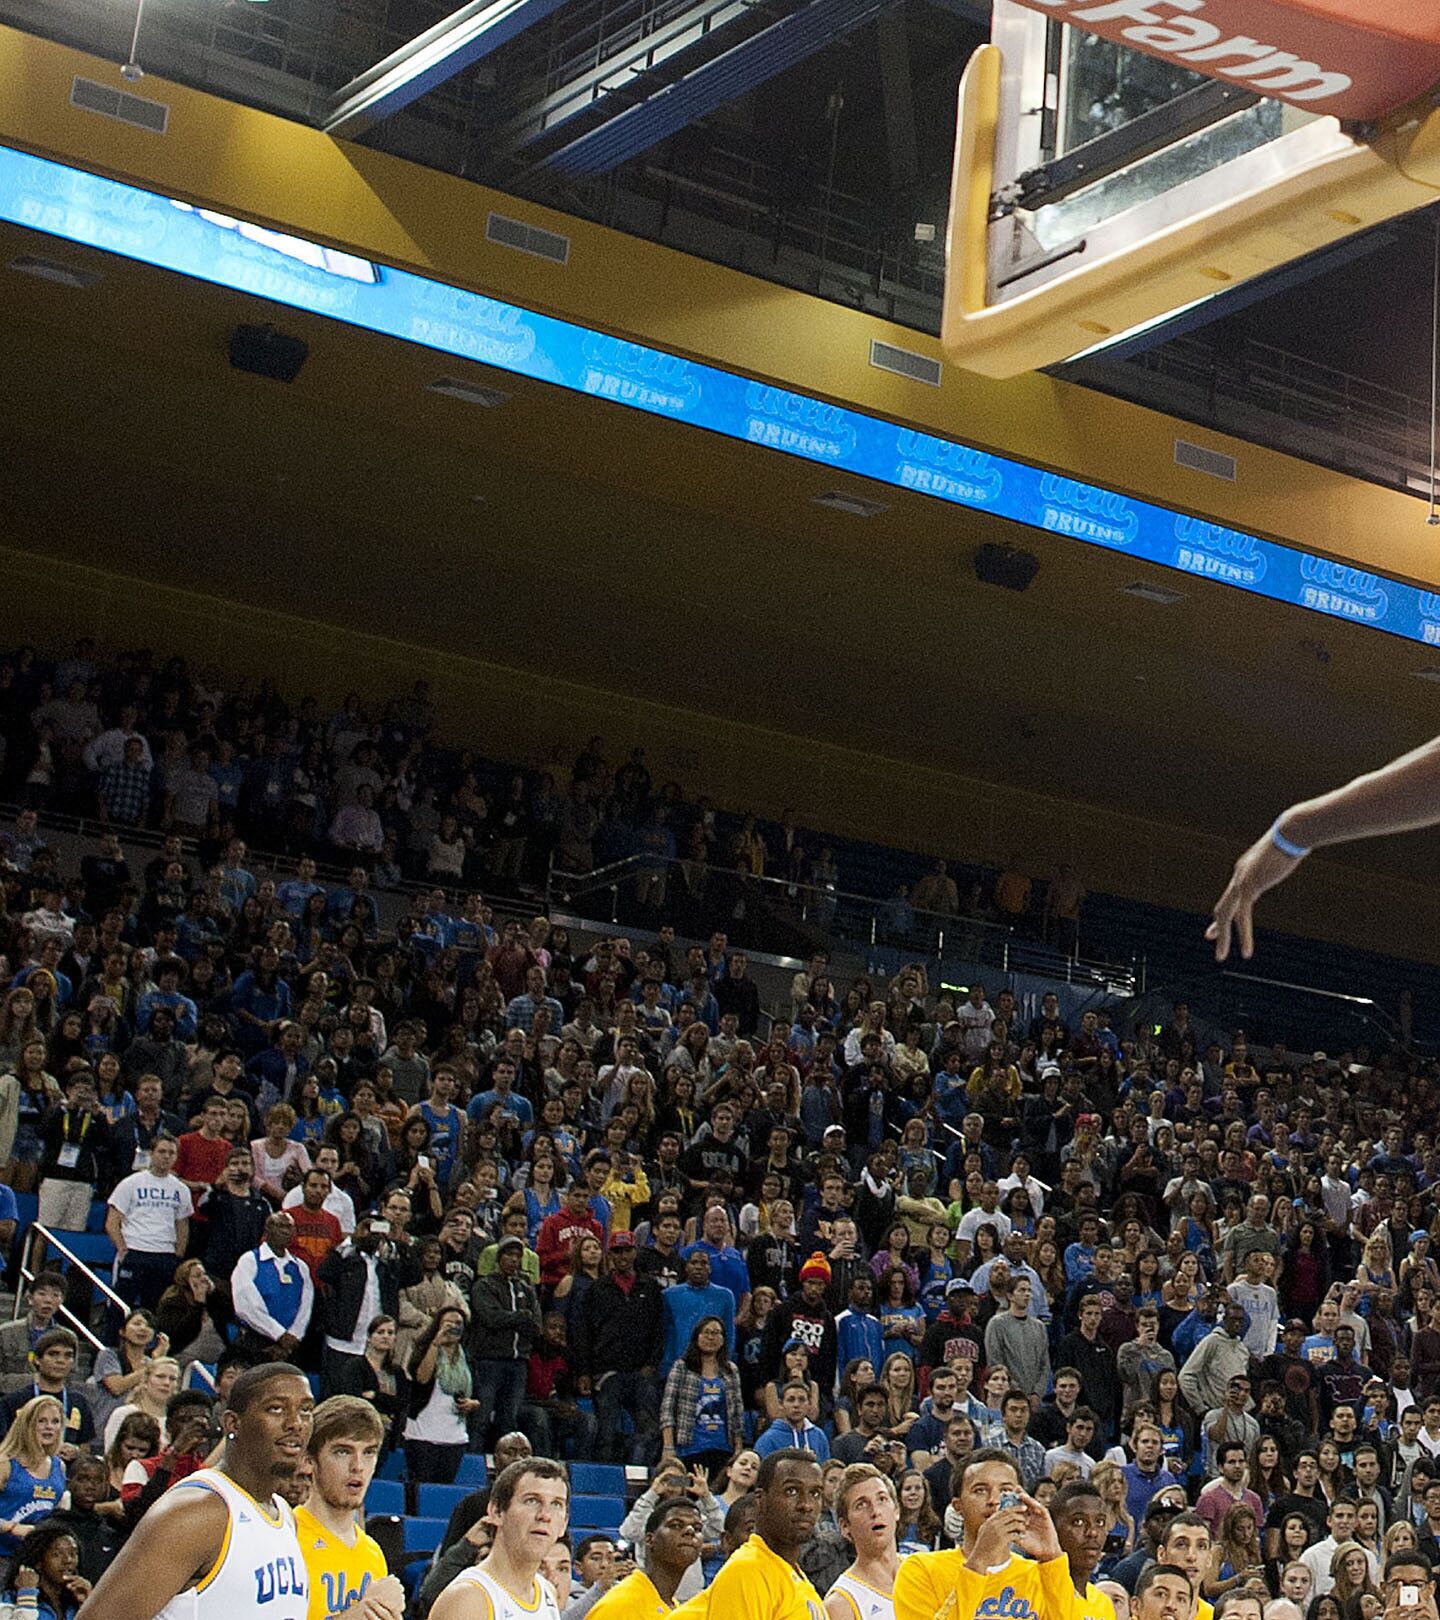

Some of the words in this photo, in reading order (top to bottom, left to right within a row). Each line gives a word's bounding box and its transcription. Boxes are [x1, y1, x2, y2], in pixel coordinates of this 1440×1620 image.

[1068, 0, 1352, 100] Farm
[901, 465, 988, 499] BRUINS
[1044, 508, 1126, 542] BRUINS
[1178, 549, 1255, 582] BRUINS
[1305, 587, 1377, 618] BRUINS
[137, 1187, 181, 1201] UCLA
[791, 1319, 825, 1336] GOD
[791, 1331, 822, 1348] CAN
[254, 1555, 308, 1605] UCL
